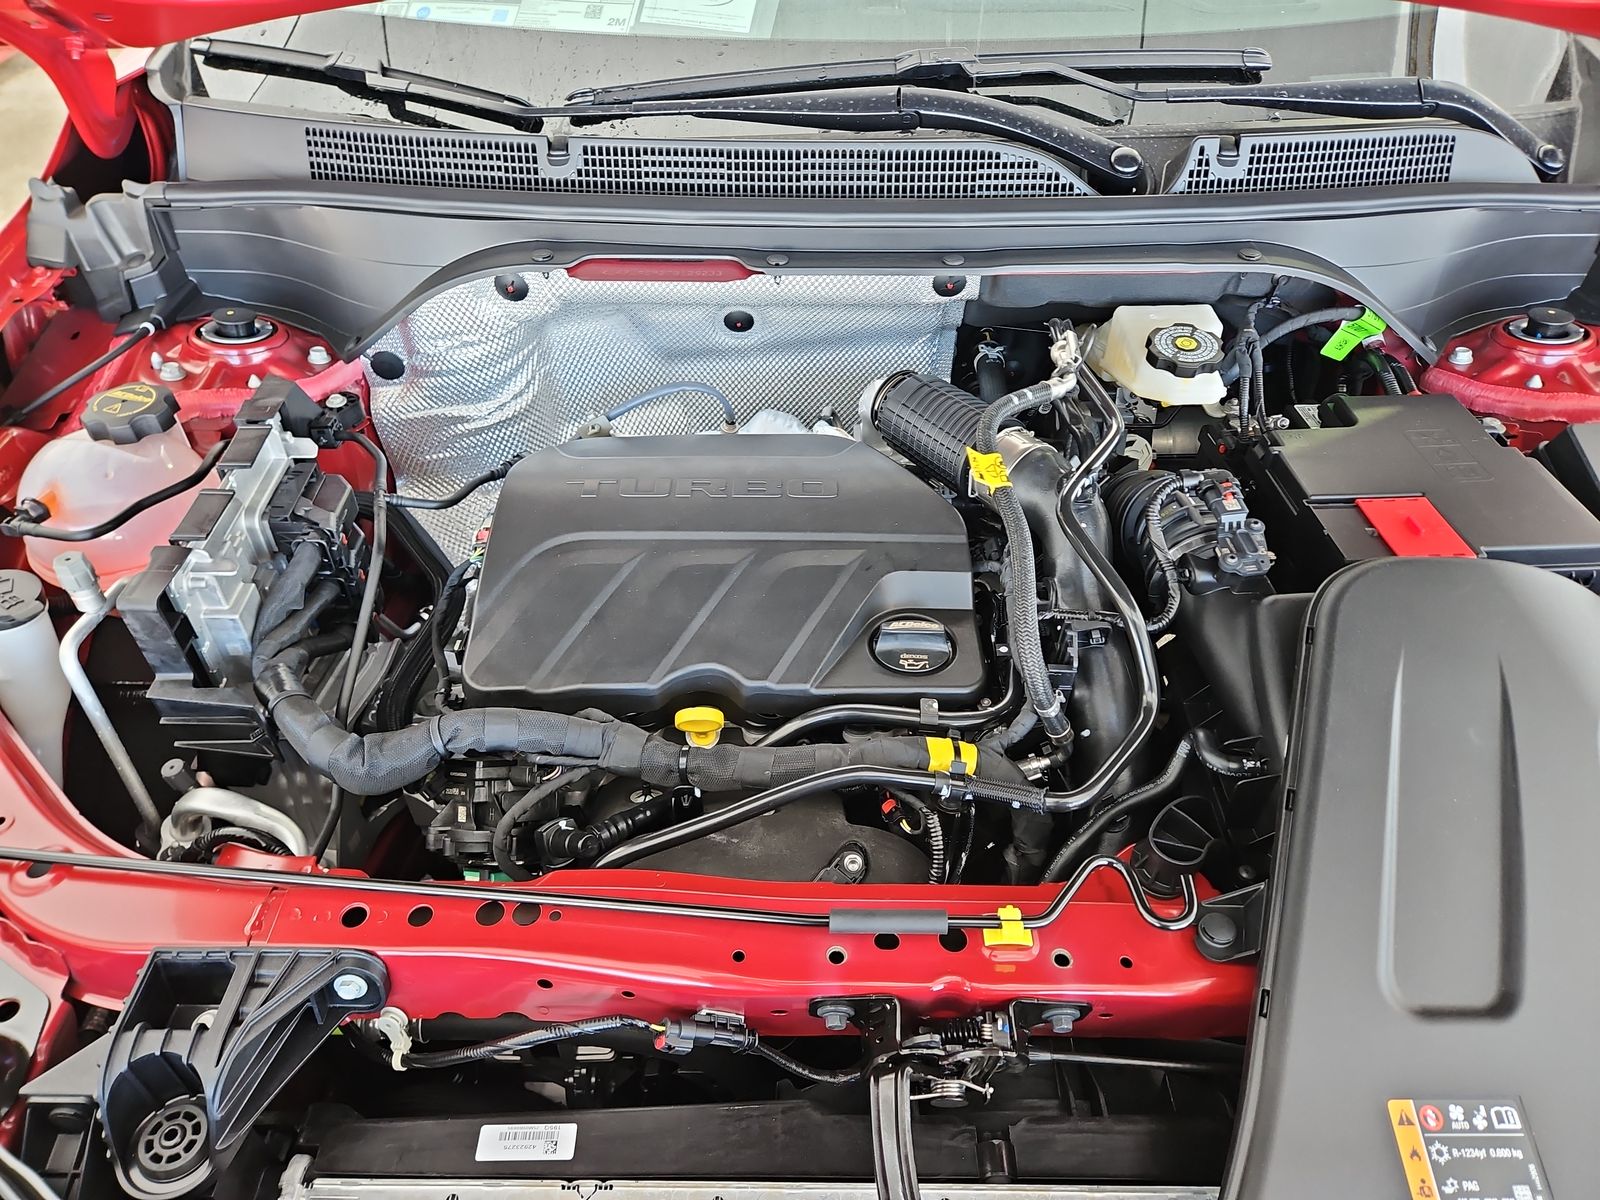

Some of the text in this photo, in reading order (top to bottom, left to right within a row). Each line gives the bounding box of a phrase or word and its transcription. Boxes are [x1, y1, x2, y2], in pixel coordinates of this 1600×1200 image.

[607, 17, 627, 27] 2M
[566, 478, 839, 498] TURBO
[889, 620, 940, 630] ACDelco
[1451, 1121, 1470, 1130] AUTO
[1461, 1180, 1480, 1192] PAG
